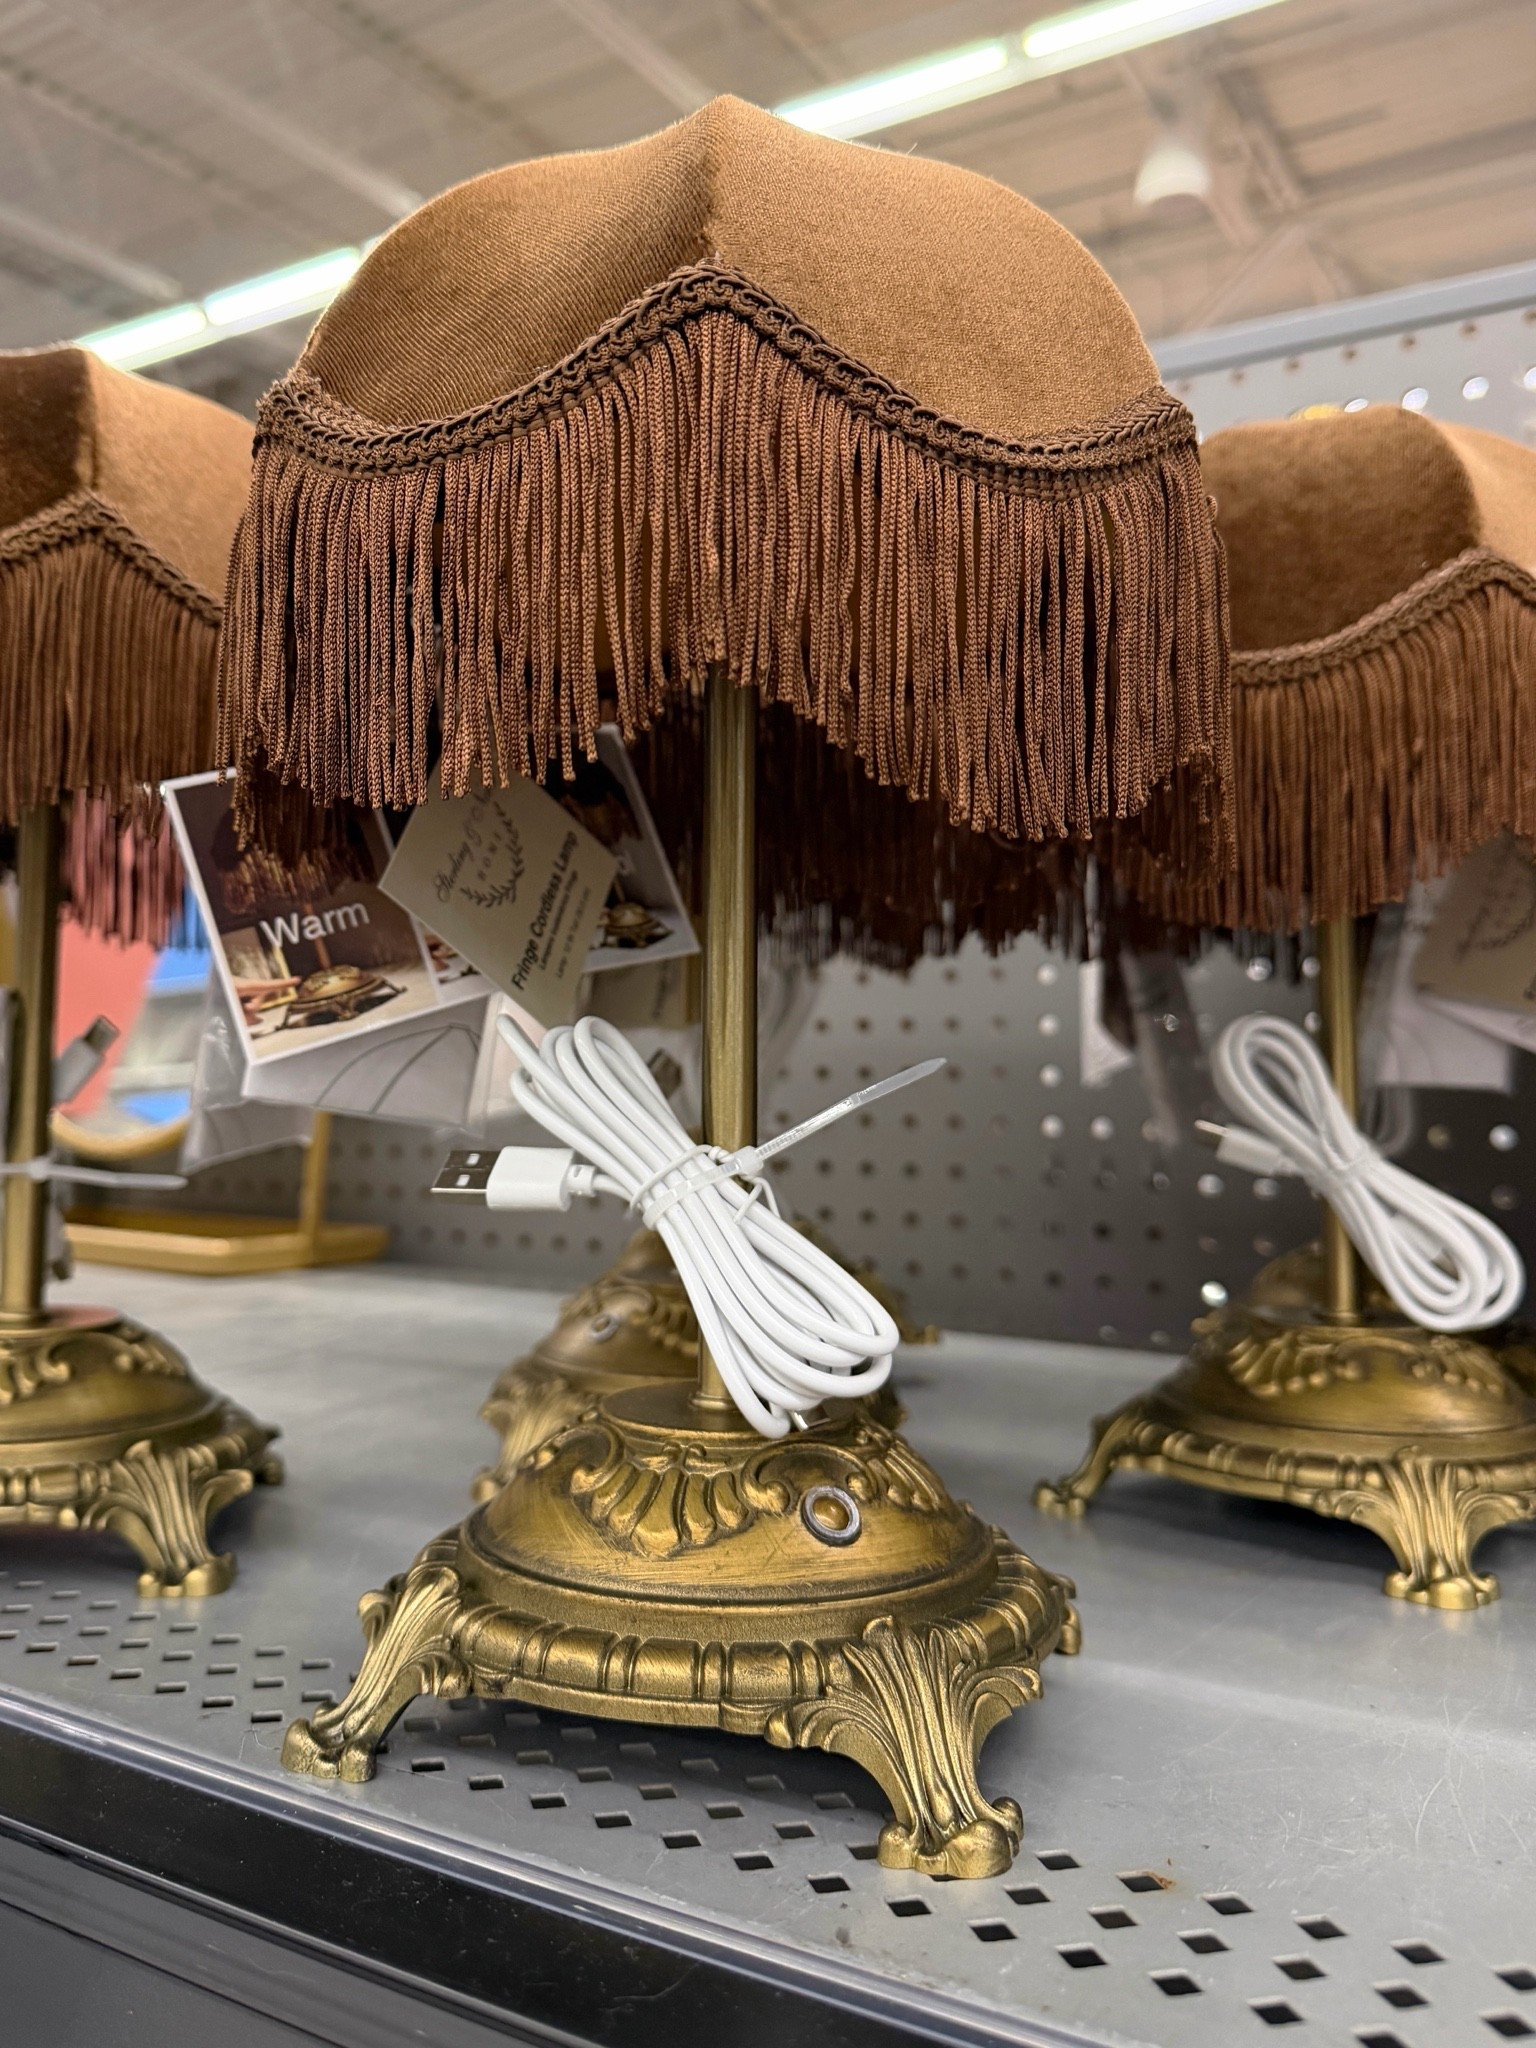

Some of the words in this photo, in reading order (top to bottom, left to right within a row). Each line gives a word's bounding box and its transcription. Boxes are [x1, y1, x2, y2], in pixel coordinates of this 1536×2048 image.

[259, 902, 370, 949] Warm
[511, 938, 540, 991] Fringe
[530, 872, 562, 938] Cordless
[554, 831, 579, 872] Lamp
